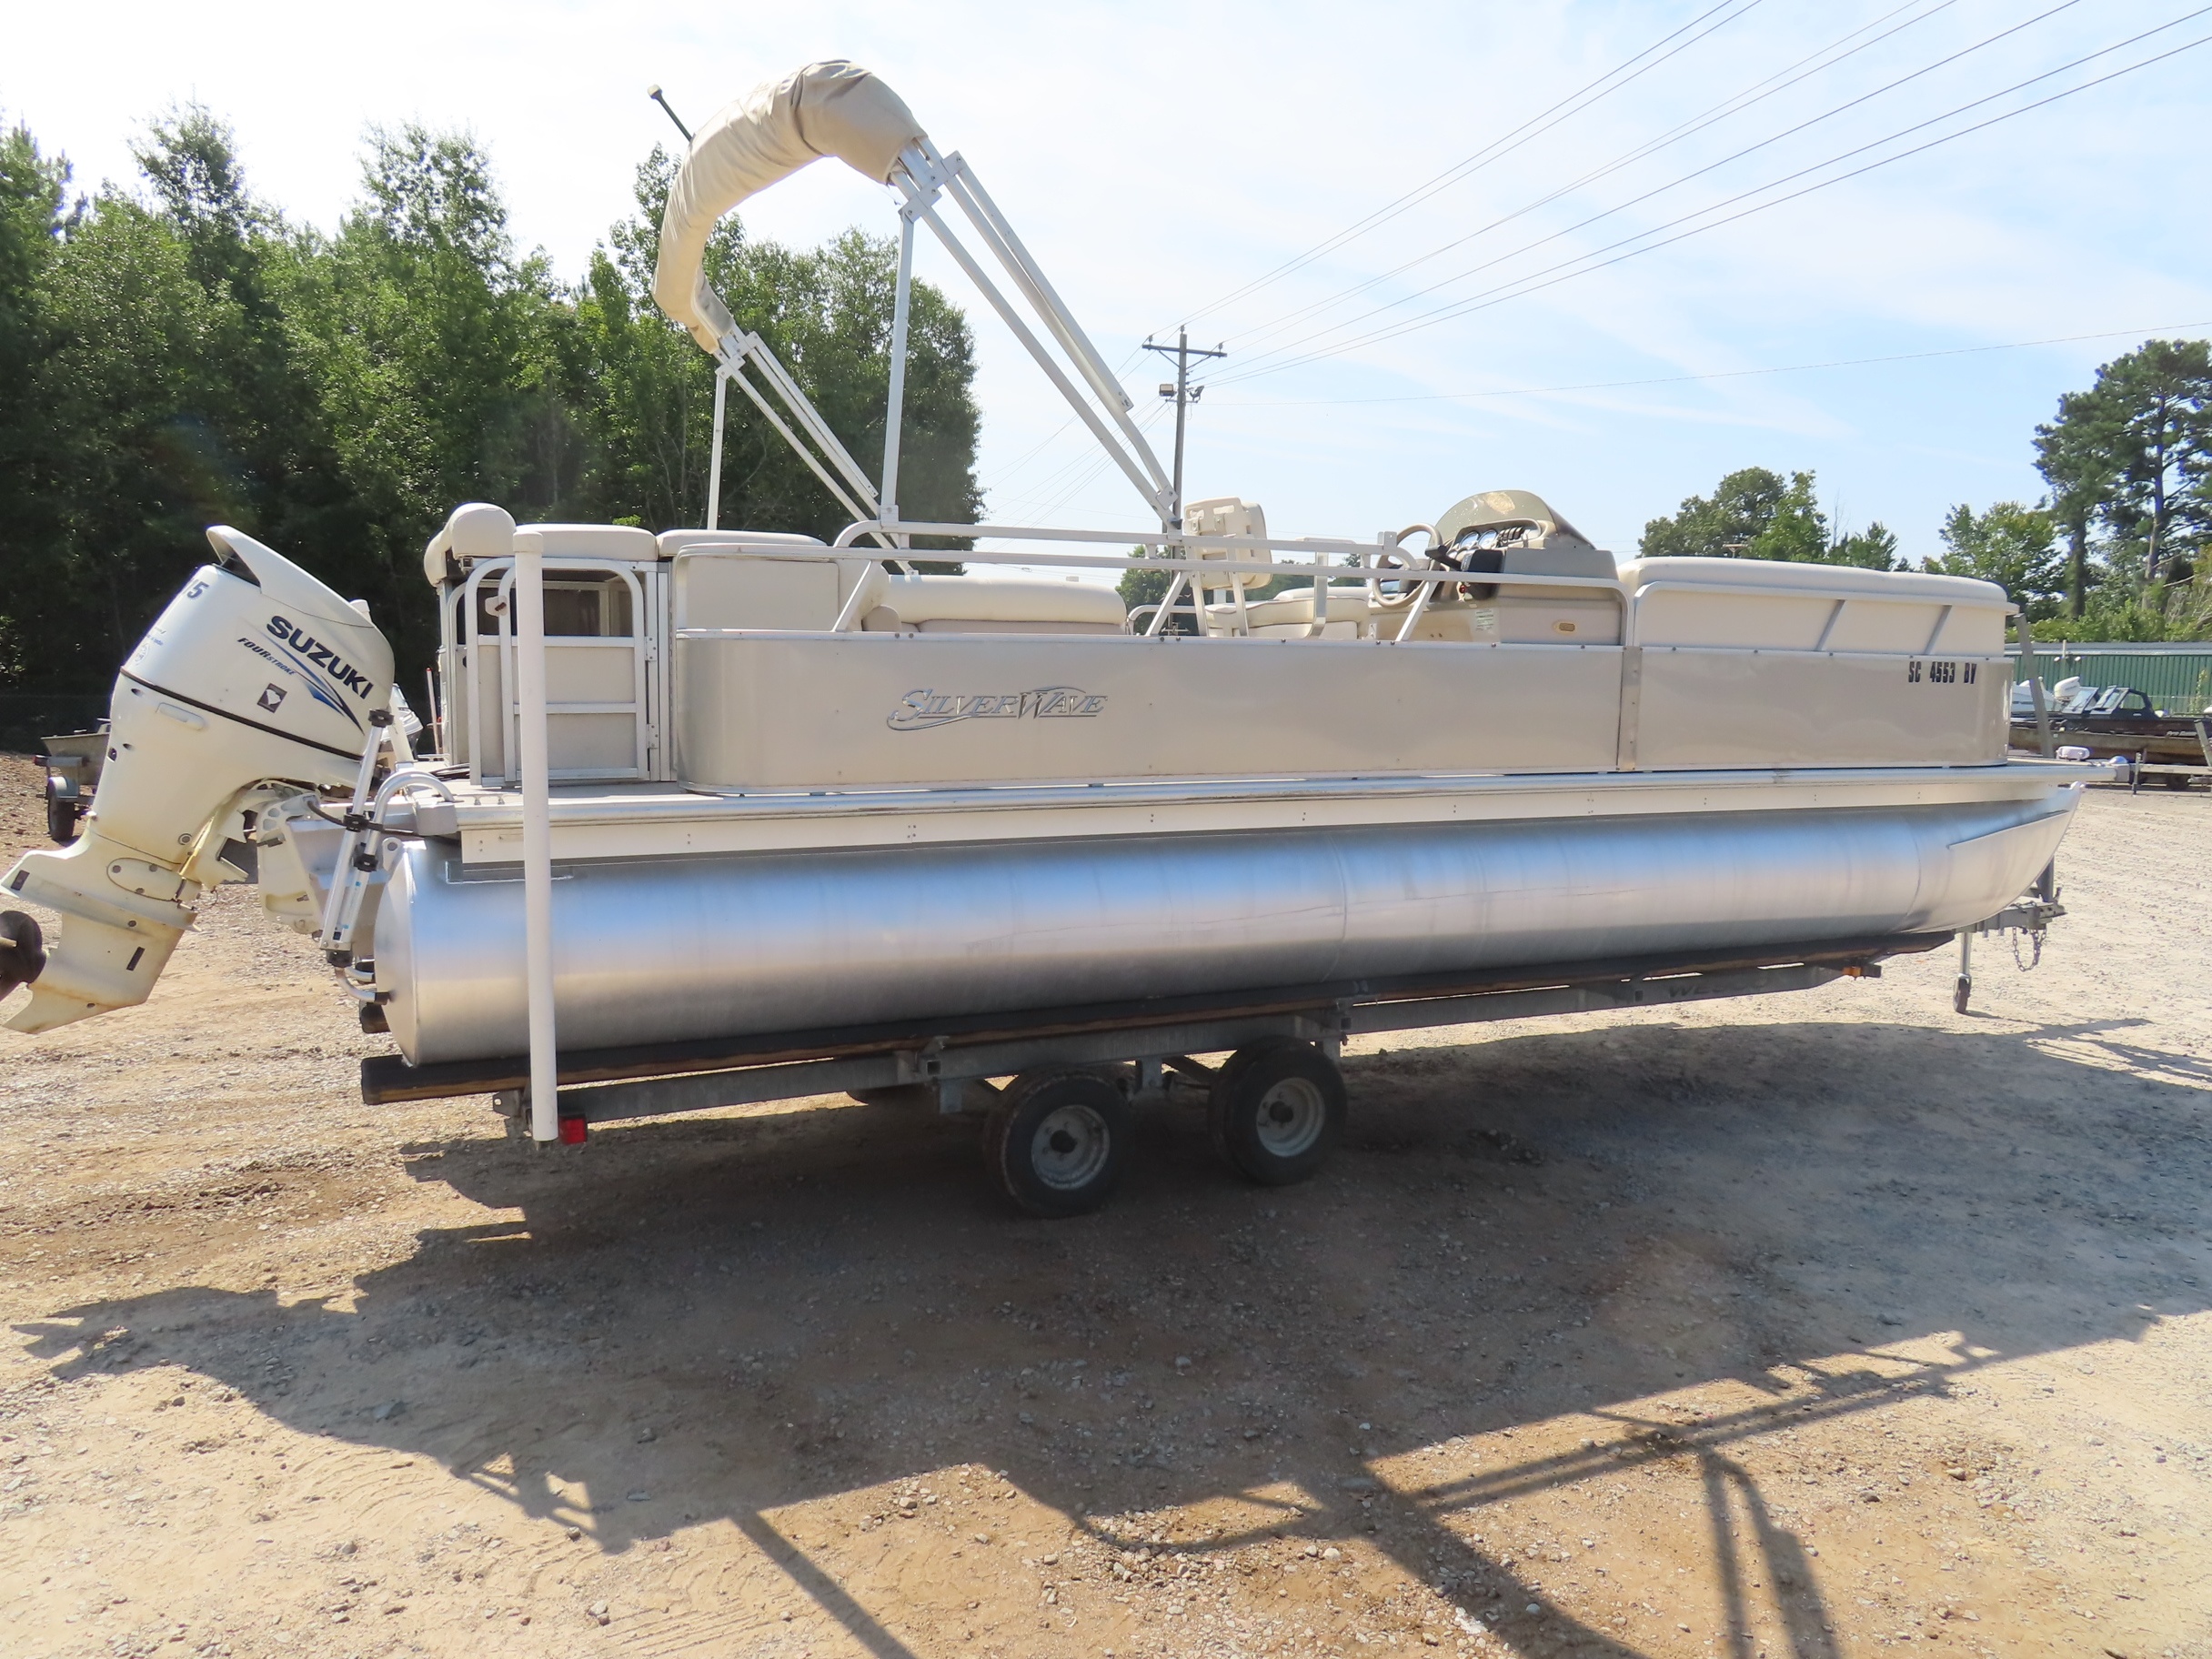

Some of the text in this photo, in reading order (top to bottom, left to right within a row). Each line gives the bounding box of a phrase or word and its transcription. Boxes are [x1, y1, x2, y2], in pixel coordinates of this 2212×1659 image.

[266, 615, 374, 699] SUZUKI
[1908, 661, 1922, 683] SC
[1929, 661, 1956, 683] 4553
